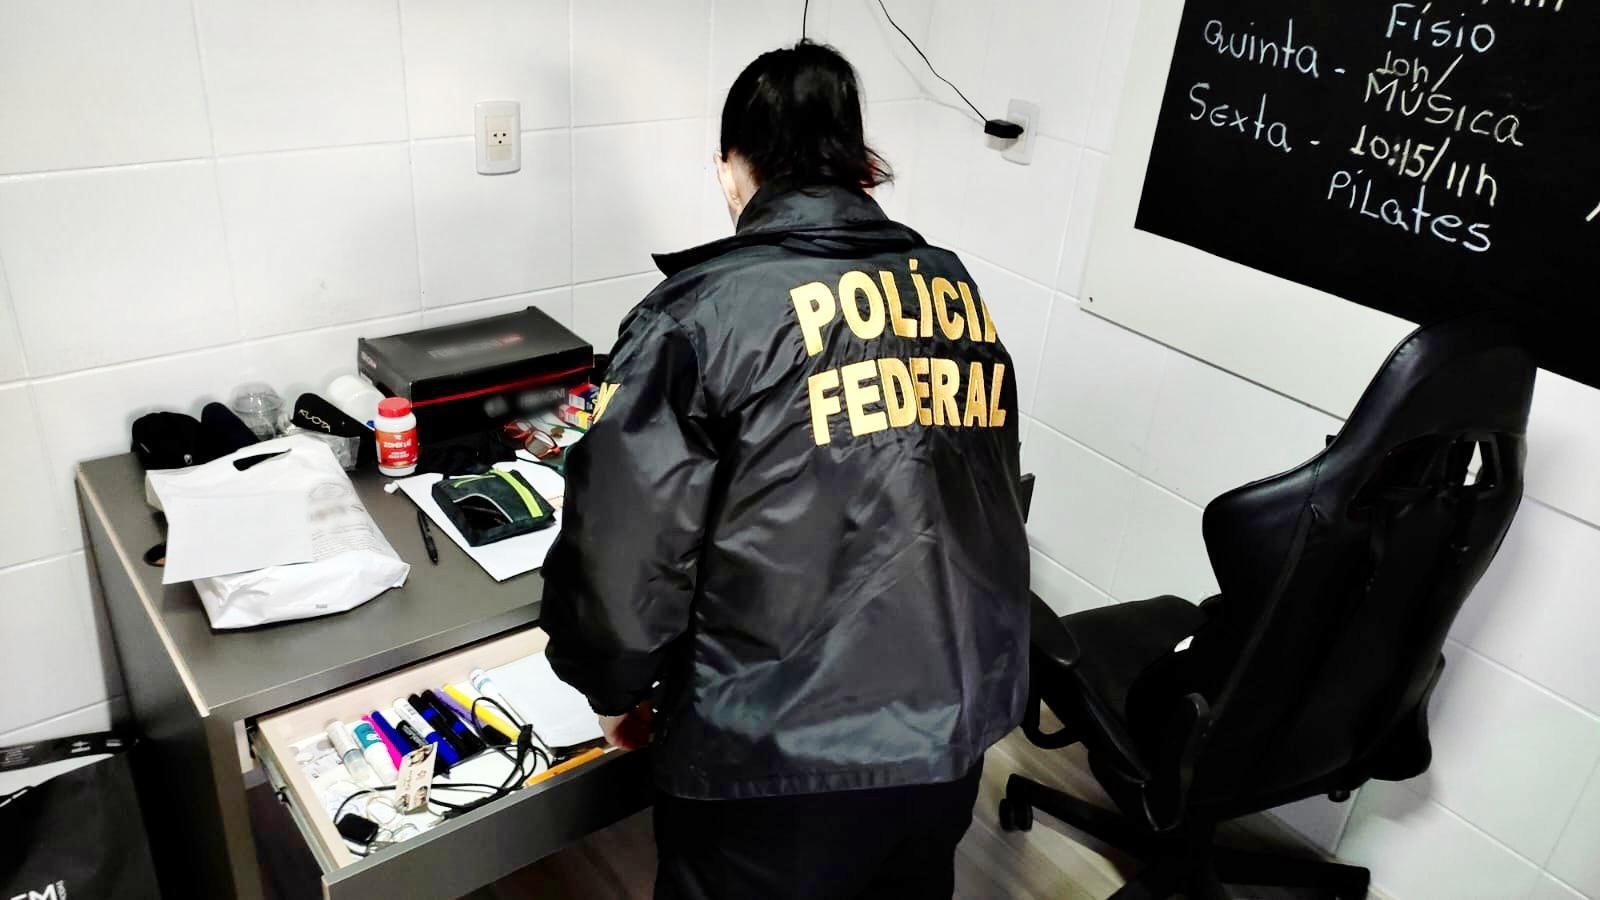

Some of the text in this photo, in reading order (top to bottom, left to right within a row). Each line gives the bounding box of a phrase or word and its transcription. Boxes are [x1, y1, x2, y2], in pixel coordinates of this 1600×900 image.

[1204, 18, 1319, 78] Quinta
[1386, 2, 1495, 53] Físio
[807, 357, 1007, 447] FEDERAL
